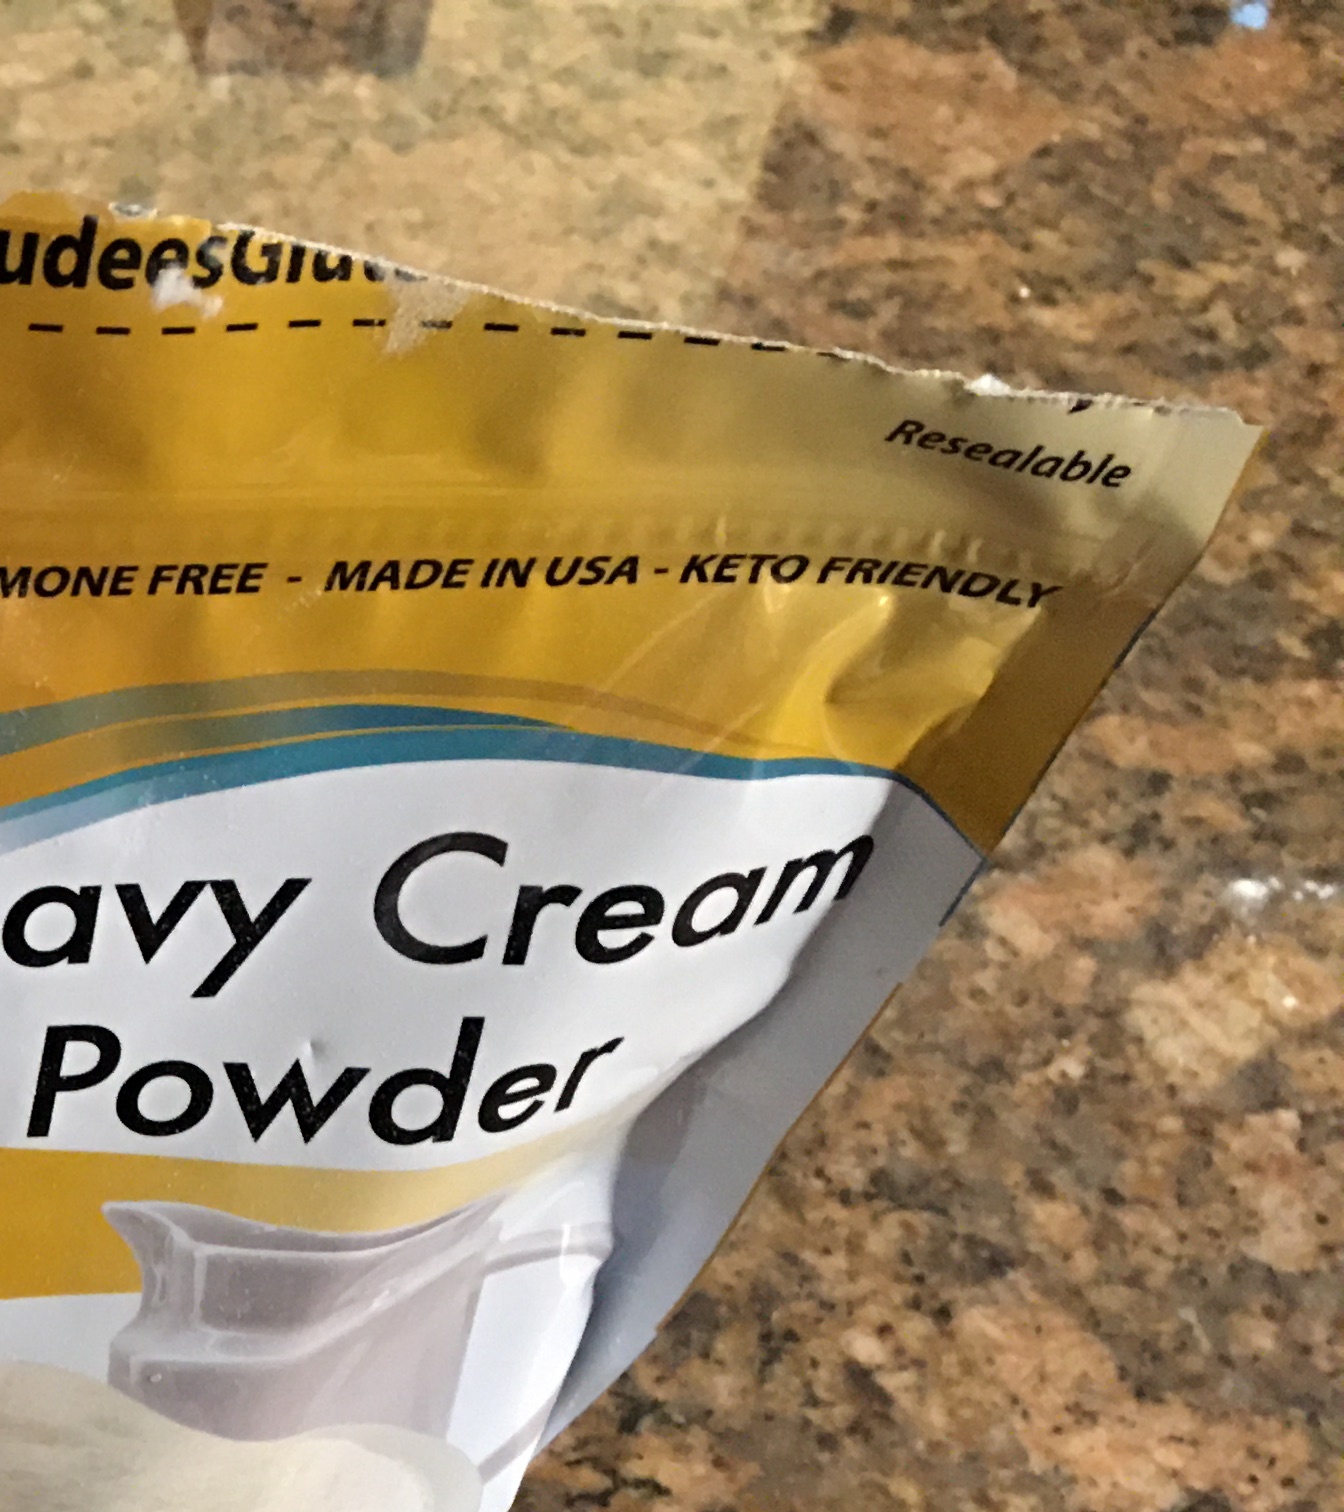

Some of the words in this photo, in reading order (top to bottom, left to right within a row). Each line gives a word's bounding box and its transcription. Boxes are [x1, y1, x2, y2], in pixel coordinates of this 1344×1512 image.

[884, 418, 1132, 489] Resealable
[147, 562, 268, 597] FREE
[324, 558, 474, 593] MADE
[479, 558, 544, 589] IN
[545, 554, 641, 587] USA
[681, 553, 810, 586] KETO
[818, 556, 1067, 610] FRIENDLY
[373, 831, 877, 967] Cream
[25, 1015, 624, 1147] Powder
